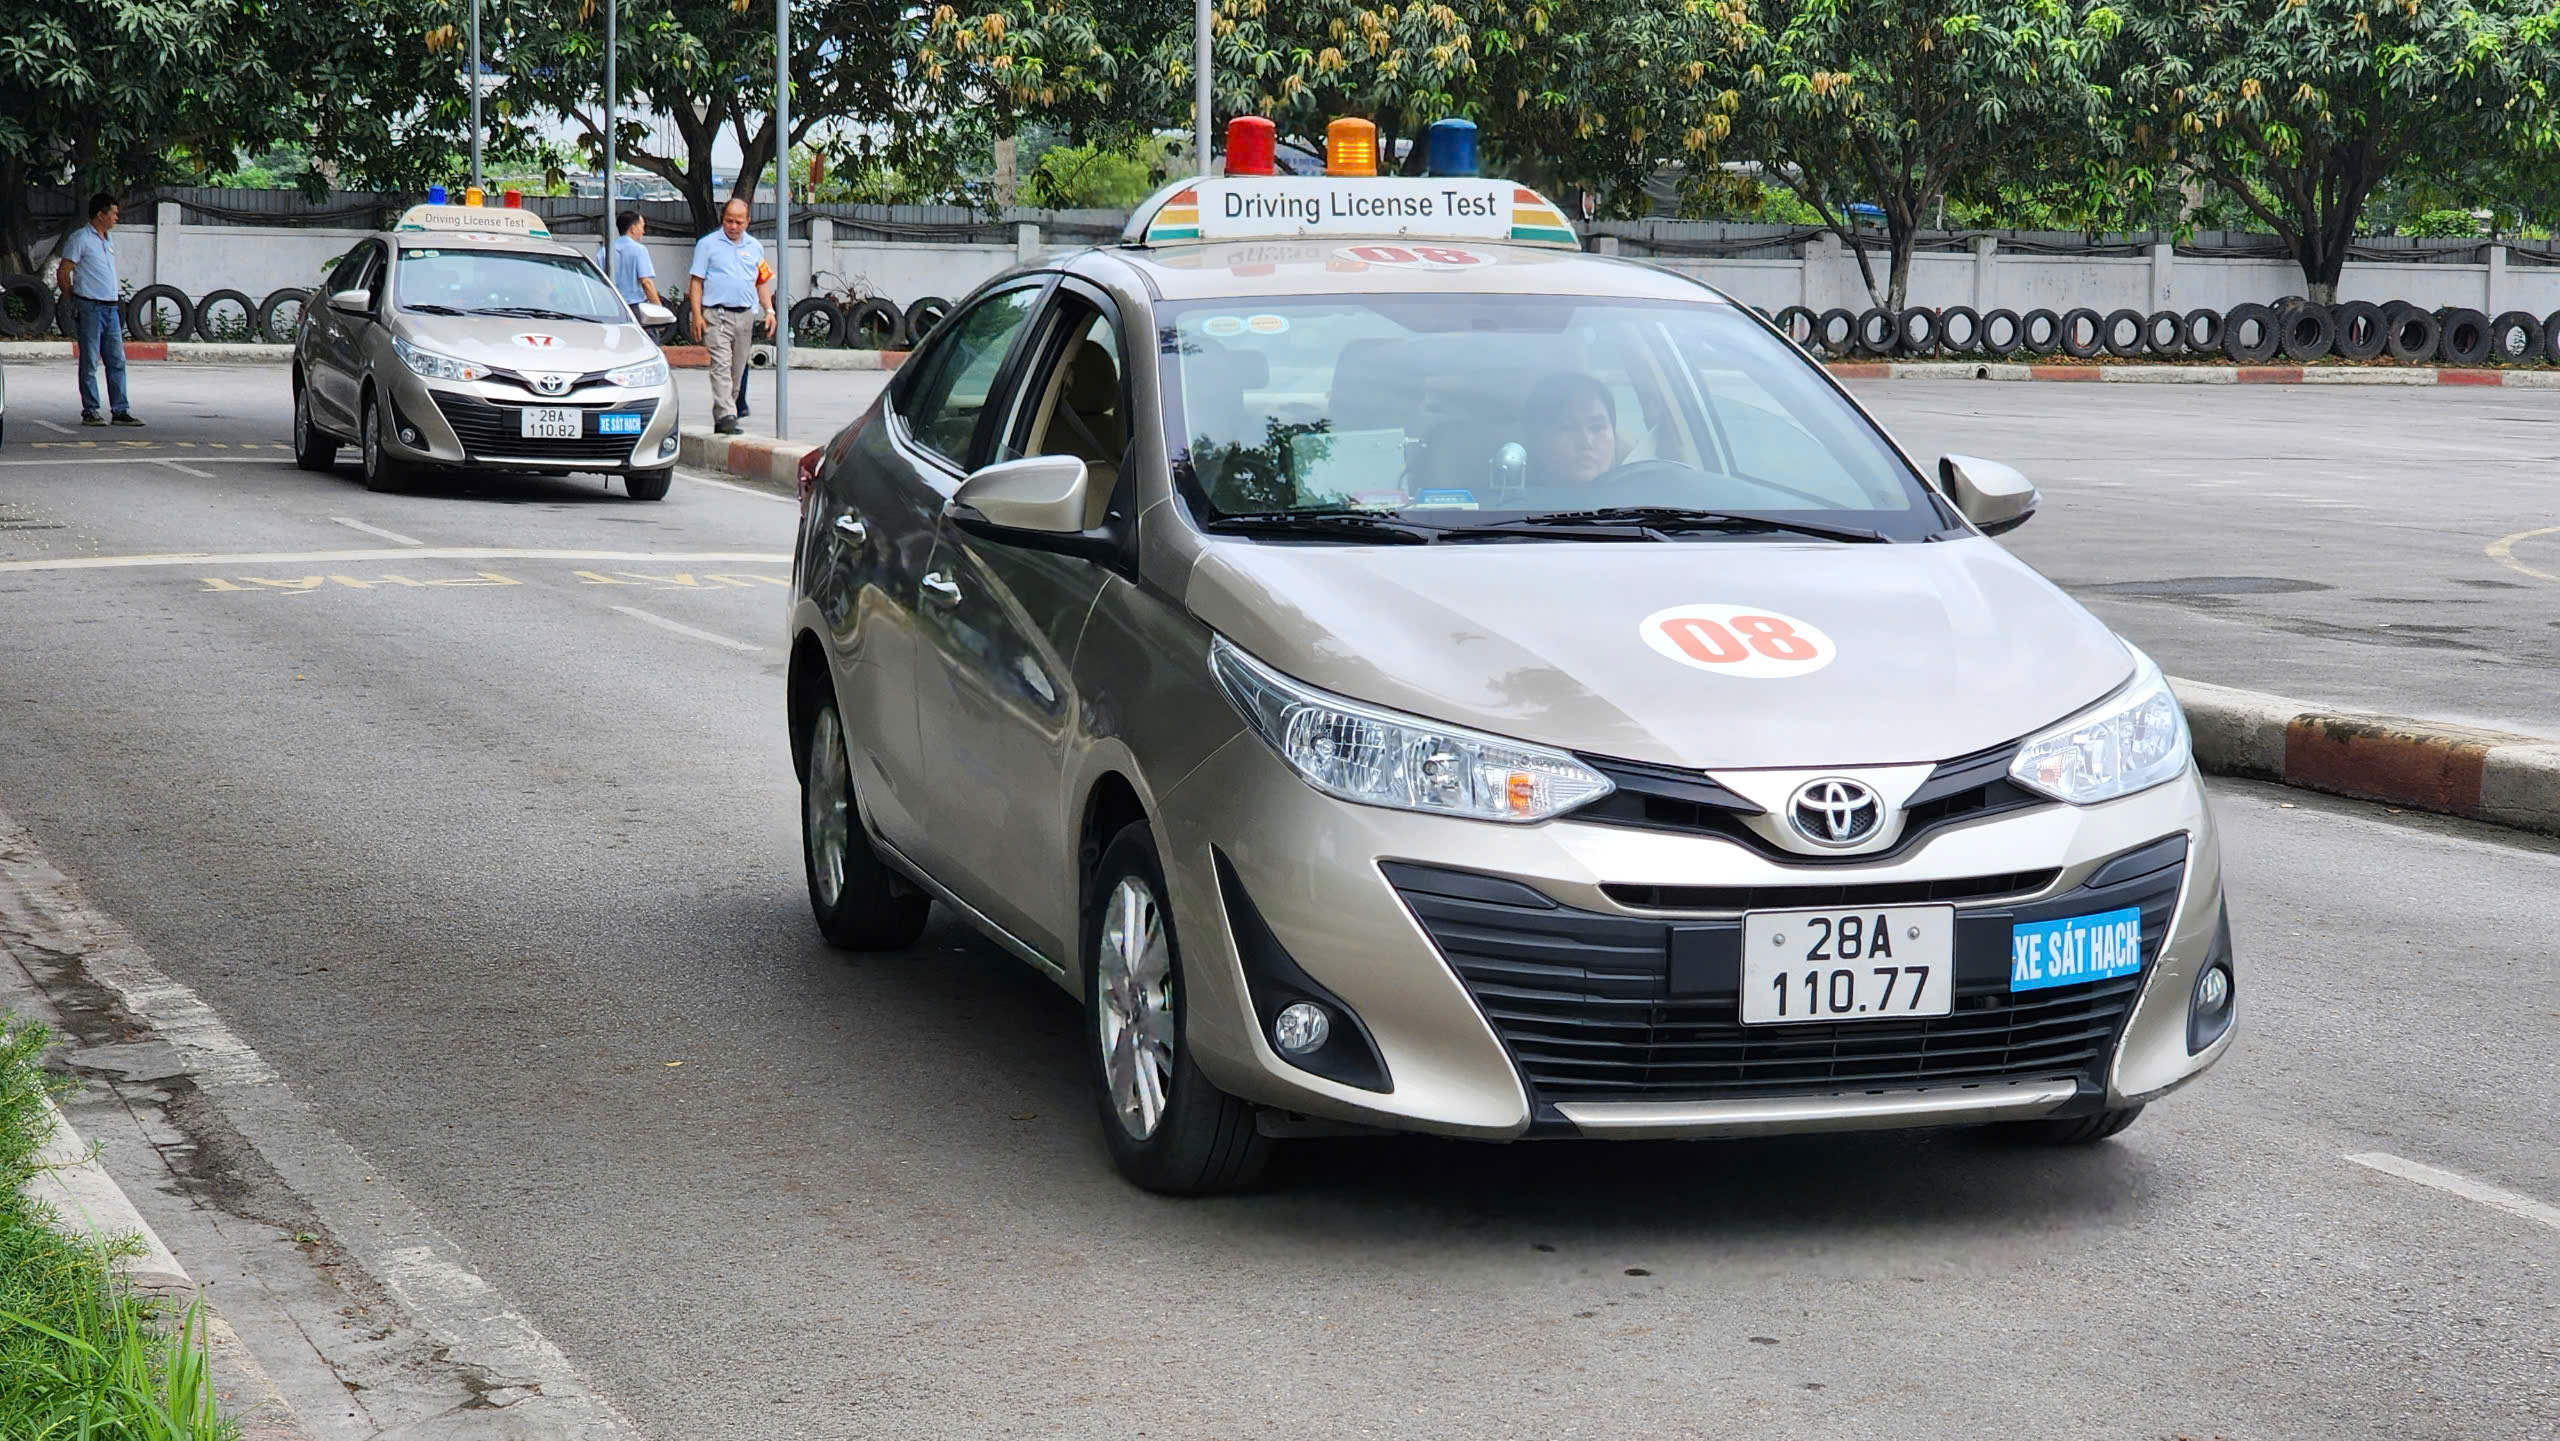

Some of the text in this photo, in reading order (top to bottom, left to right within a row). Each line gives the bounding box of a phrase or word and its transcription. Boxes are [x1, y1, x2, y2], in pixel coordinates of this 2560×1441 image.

[425, 213, 525, 228] Driving License Test
[1225, 191, 1497, 225] Driving License Test
[1349, 246, 1481, 265] 08
[520, 335, 554, 347] 17
[539, 409, 565, 423] 28A
[530, 424, 576, 437] 110.82
[1659, 615, 1819, 664] 08
[1806, 914, 1893, 962] 28A
[2014, 919, 2139, 981] XE SÁT HẠCH
[1773, 966, 1931, 1017] 110.77
